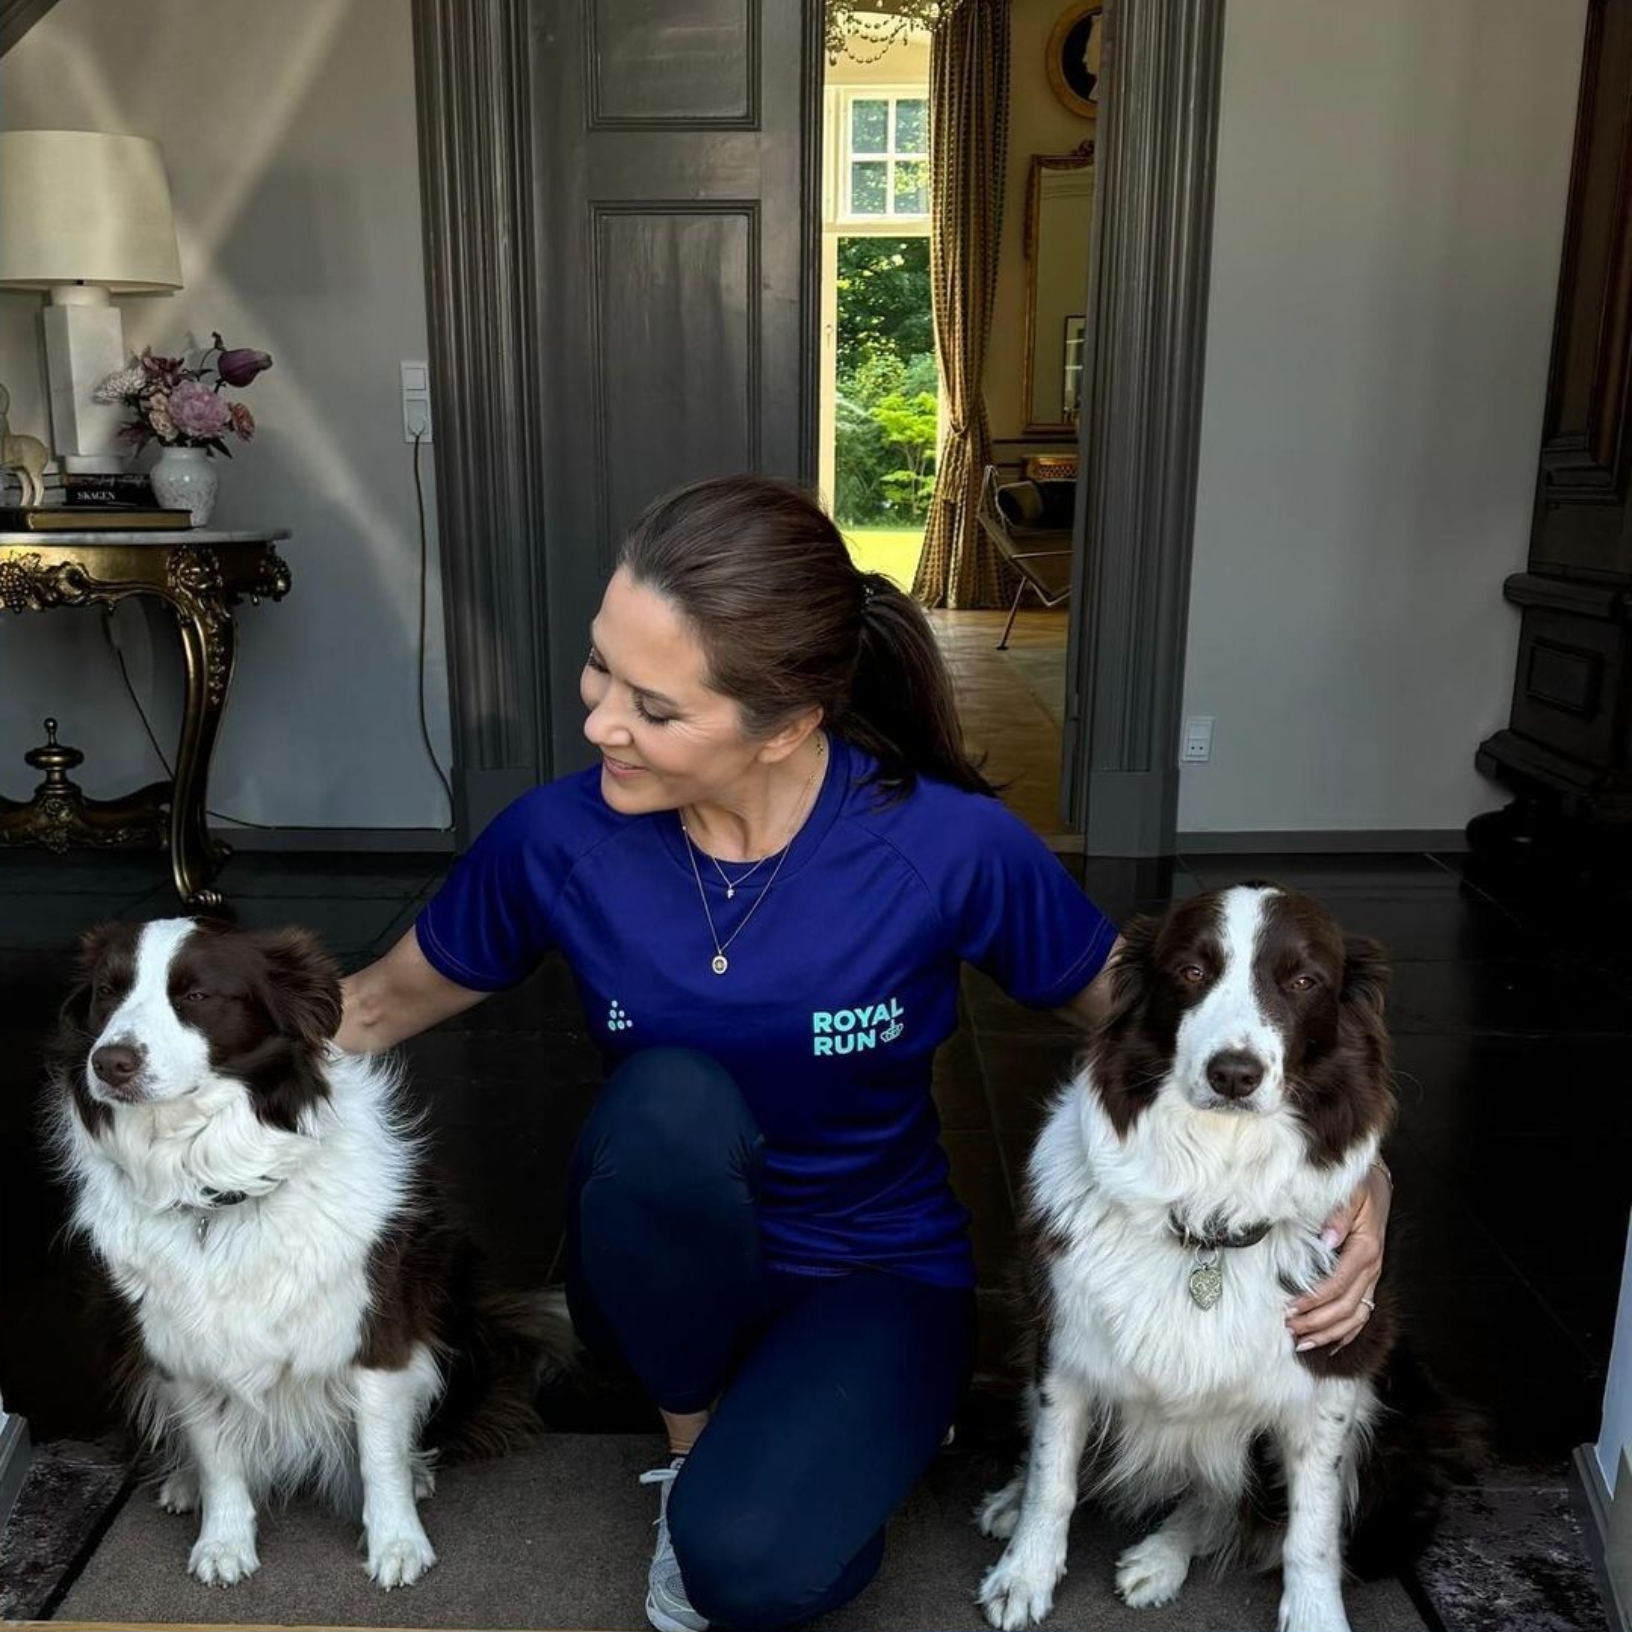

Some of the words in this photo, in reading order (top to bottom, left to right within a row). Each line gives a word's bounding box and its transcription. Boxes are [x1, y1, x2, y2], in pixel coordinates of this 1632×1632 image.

[77, 491, 116, 500] SKAGEN
[813, 997, 904, 1034] ROYAL
[814, 1029, 876, 1056] RUN
